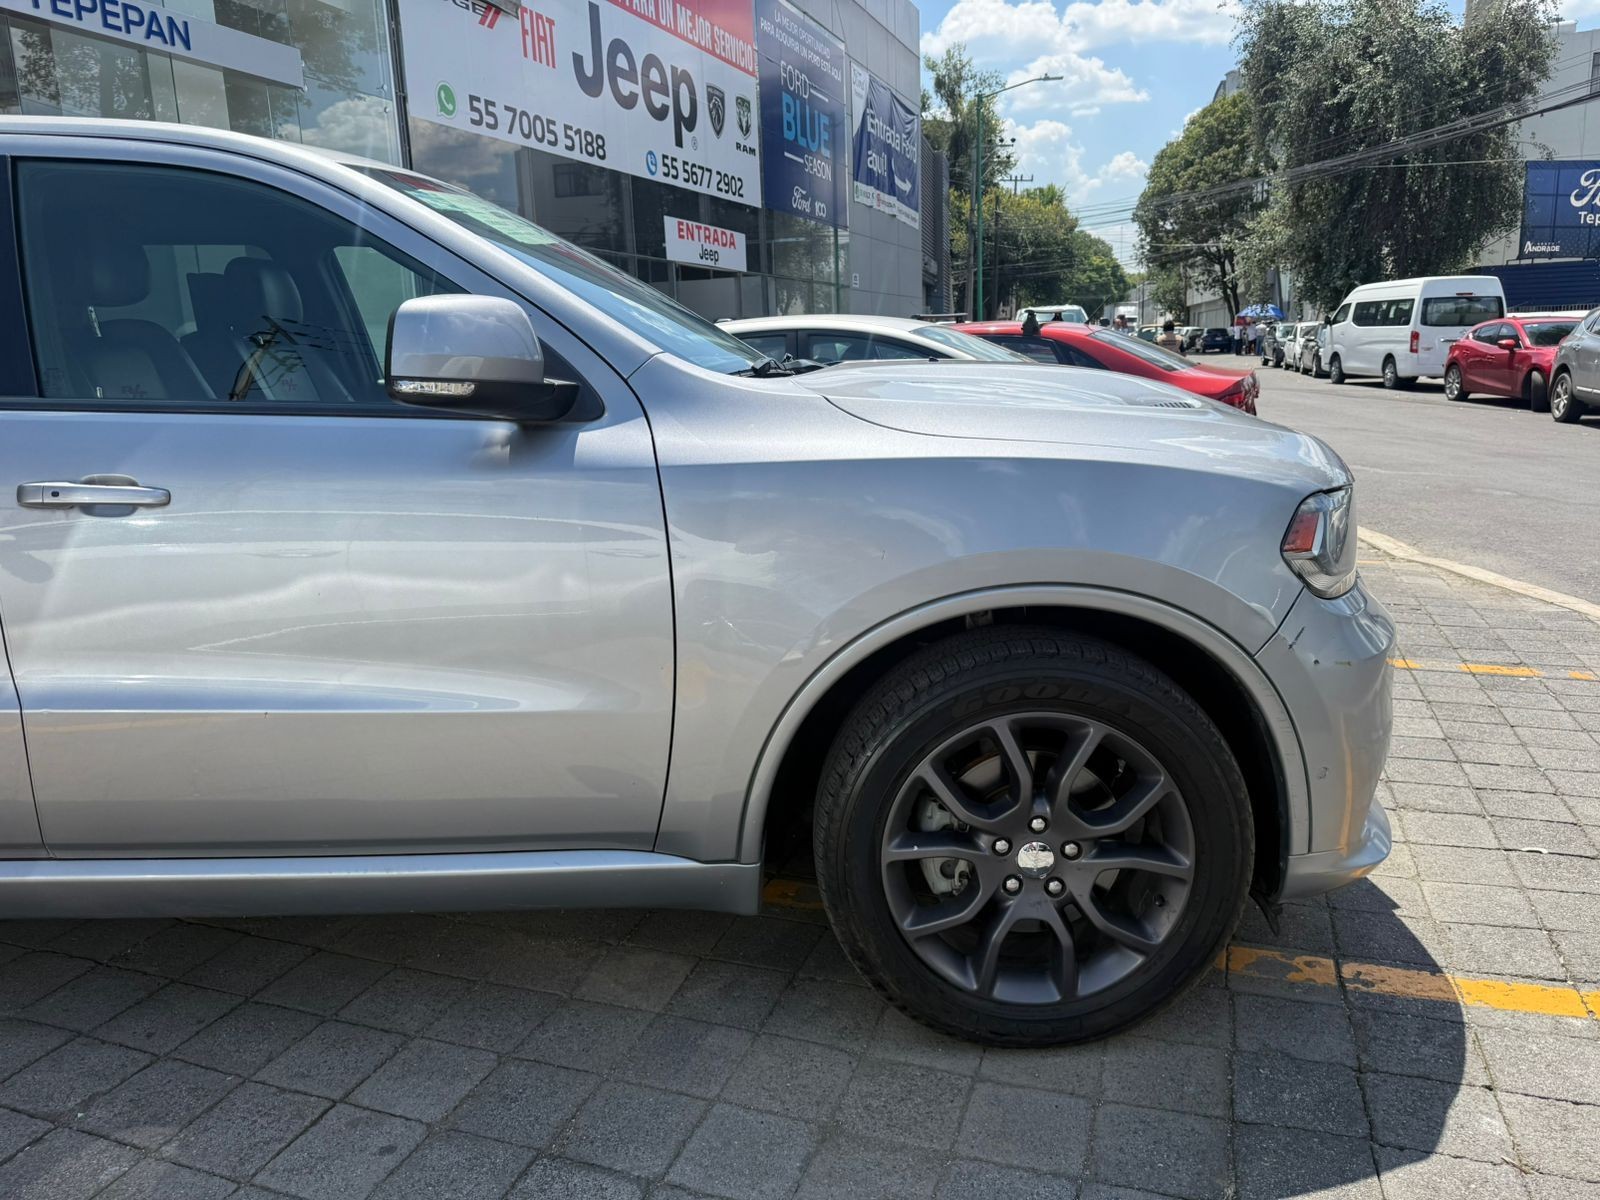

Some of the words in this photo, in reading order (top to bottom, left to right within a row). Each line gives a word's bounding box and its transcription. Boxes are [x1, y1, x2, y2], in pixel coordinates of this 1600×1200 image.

[32, 0, 191, 51] EPEPAN
[520, 5, 556, 69] FIAT
[659, 0, 674, 30] UN
[677, 3, 712, 50] MEJOR
[714, 24, 754, 72] SERVICIO
[572, 1, 698, 148] Jeep
[780, 60, 810, 99] FORD
[468, 94, 499, 131] 55
[503, 104, 558, 147] 7005
[563, 123, 607, 161] 5188
[782, 91, 831, 159] BLUE
[736, 141, 757, 157] RAM
[804, 154, 832, 182] SEASON
[661, 154, 679, 180] 55
[682, 160, 714, 190] 5677
[715, 170, 745, 199] 2902
[791, 185, 811, 213] Ford
[677, 220, 737, 250] ENTRADA
[698, 244, 720, 266] Jeep
